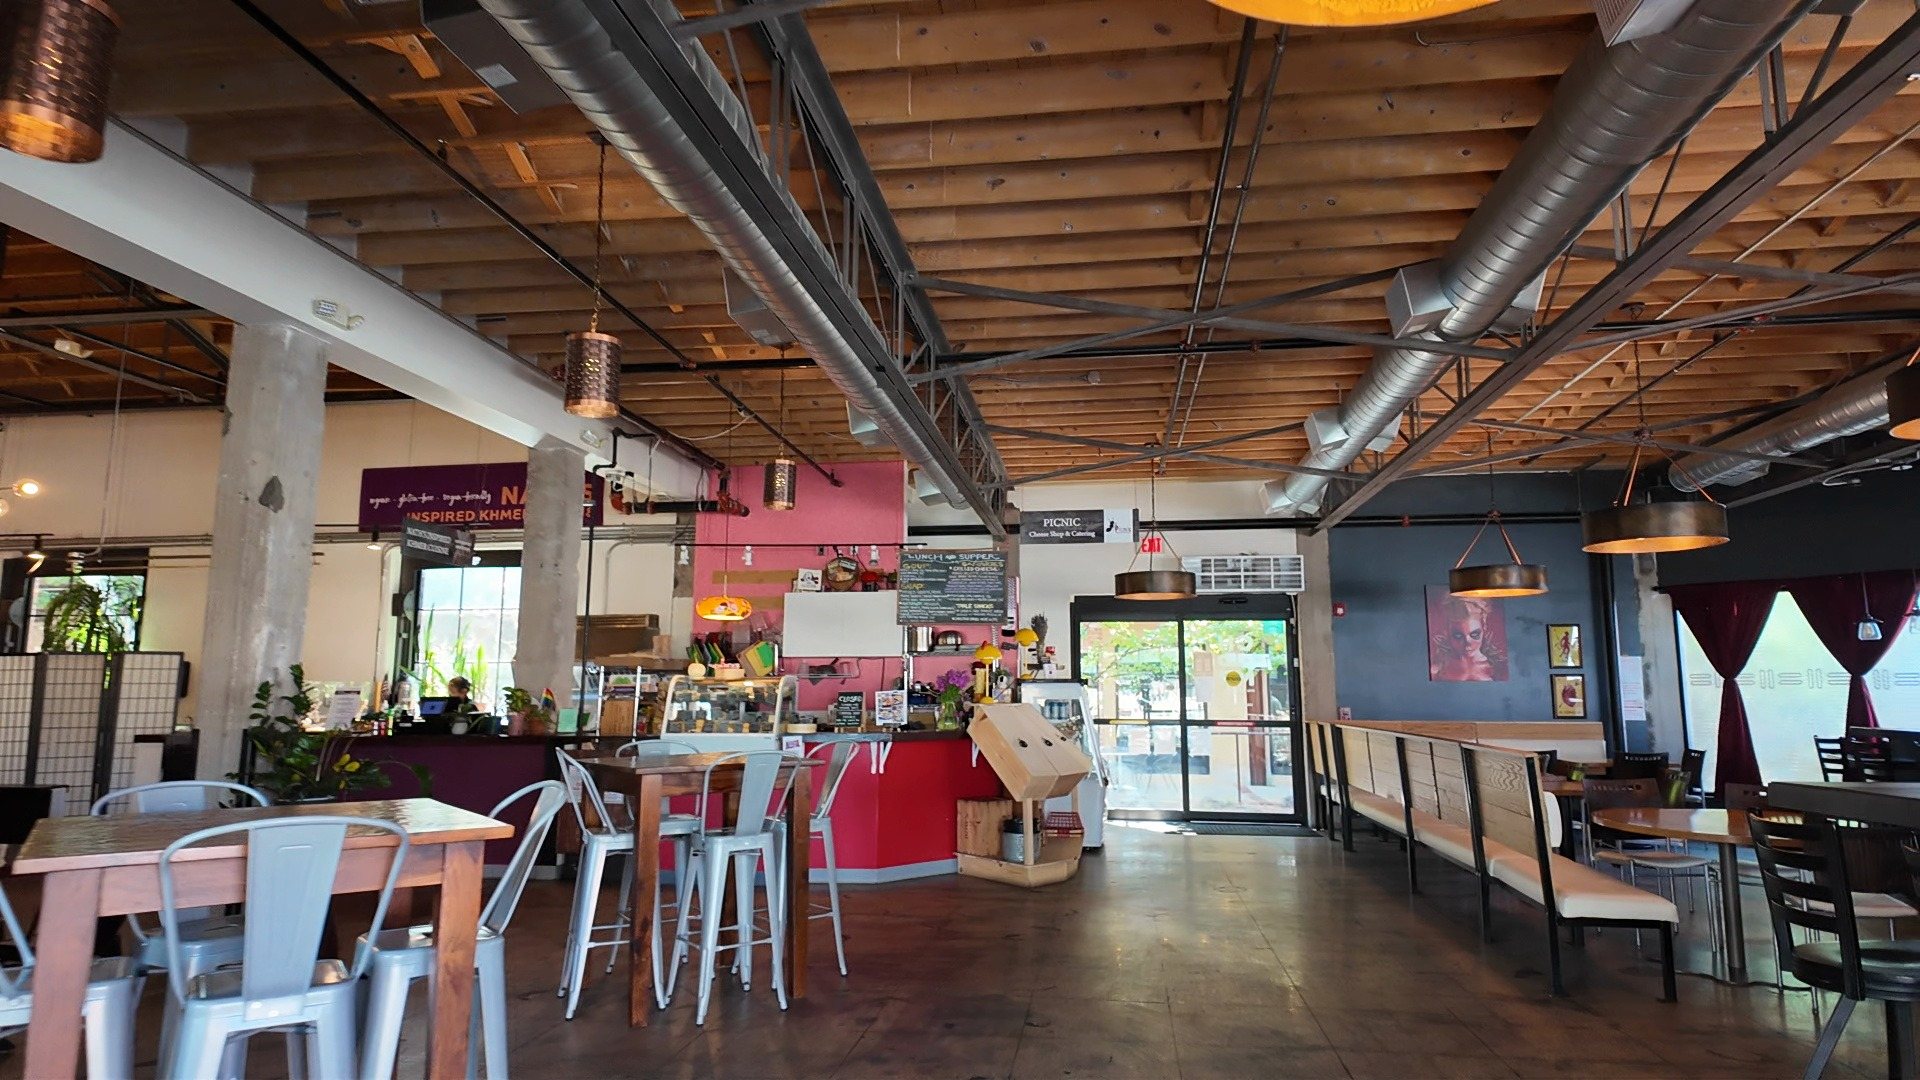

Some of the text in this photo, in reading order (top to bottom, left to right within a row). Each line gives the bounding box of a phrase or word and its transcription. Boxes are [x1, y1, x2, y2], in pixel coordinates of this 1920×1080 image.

[479, 508, 526, 521] KHME
[1043, 517, 1082, 527] PICNIC
[1050, 530, 1064, 539] Shop
[1071, 530, 1096, 539] Catering
[904, 553, 943, 561] LUNCH
